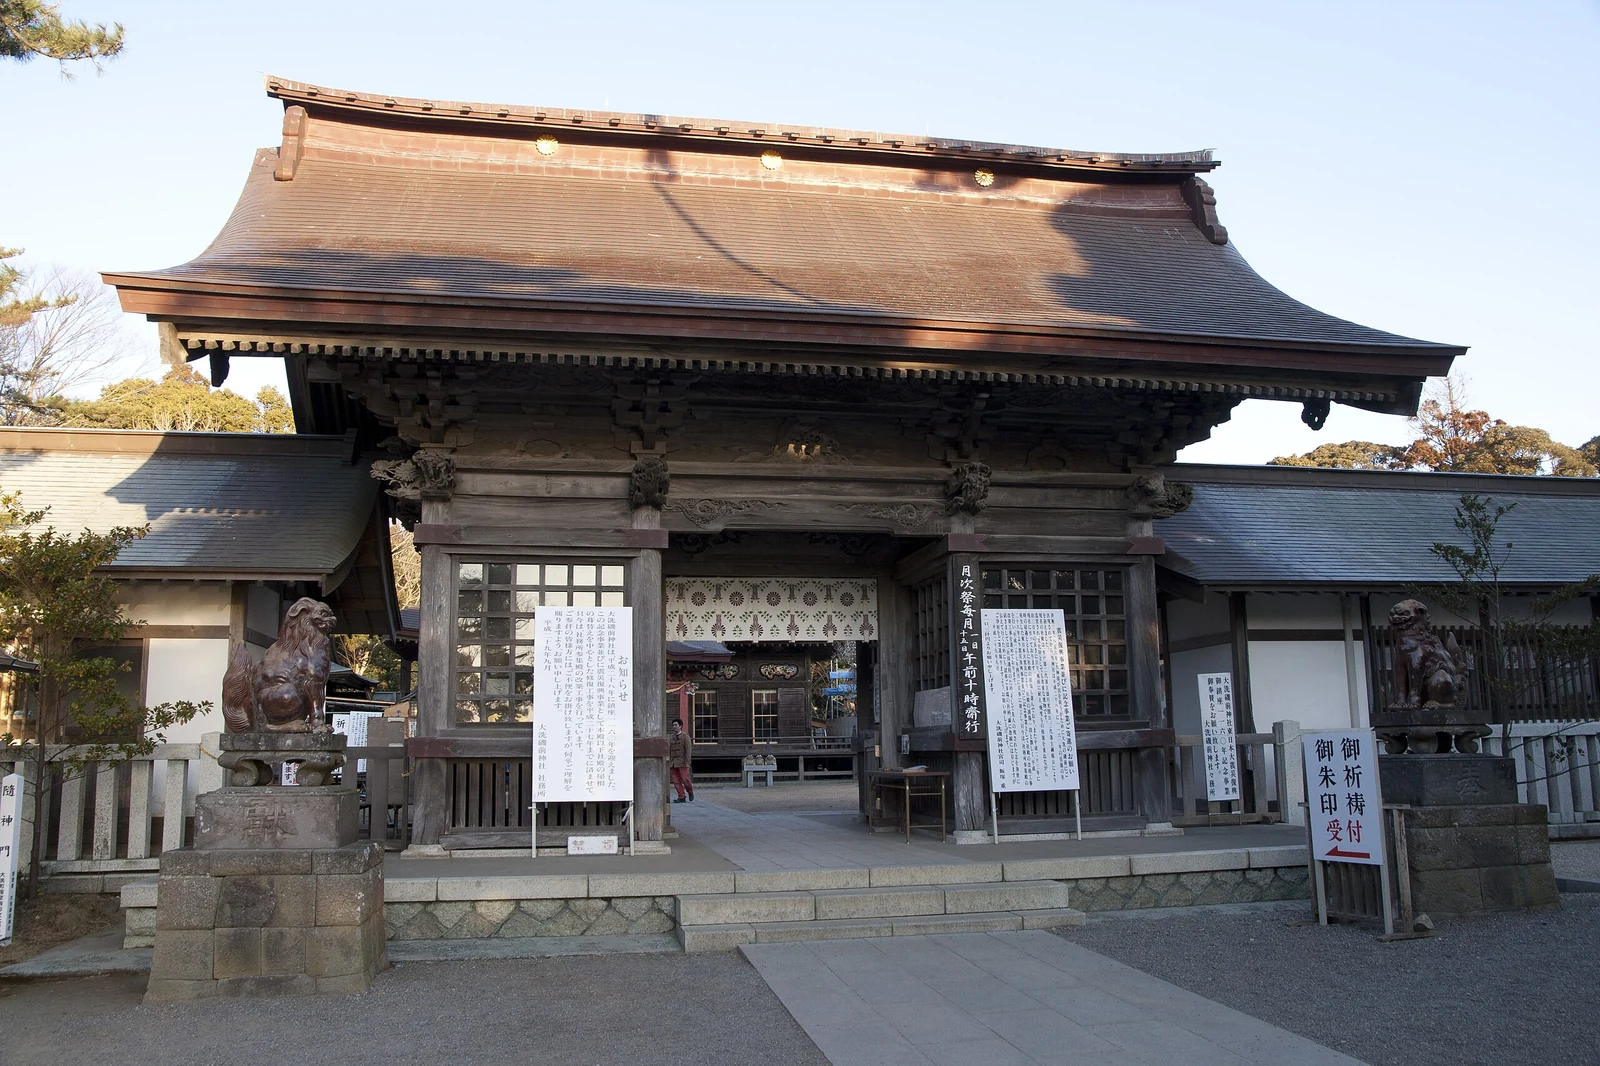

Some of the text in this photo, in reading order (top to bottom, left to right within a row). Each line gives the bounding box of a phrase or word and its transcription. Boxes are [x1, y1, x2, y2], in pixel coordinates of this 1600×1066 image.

[618, 655, 628, 702] お知らせ
[537, 723, 547, 798] 大洗磯前神社 社務所
[1315, 738, 1338, 816] 御朱印
[1340, 737, 1366, 816] 御祈祷
[1326, 818, 1362, 844] 受付
